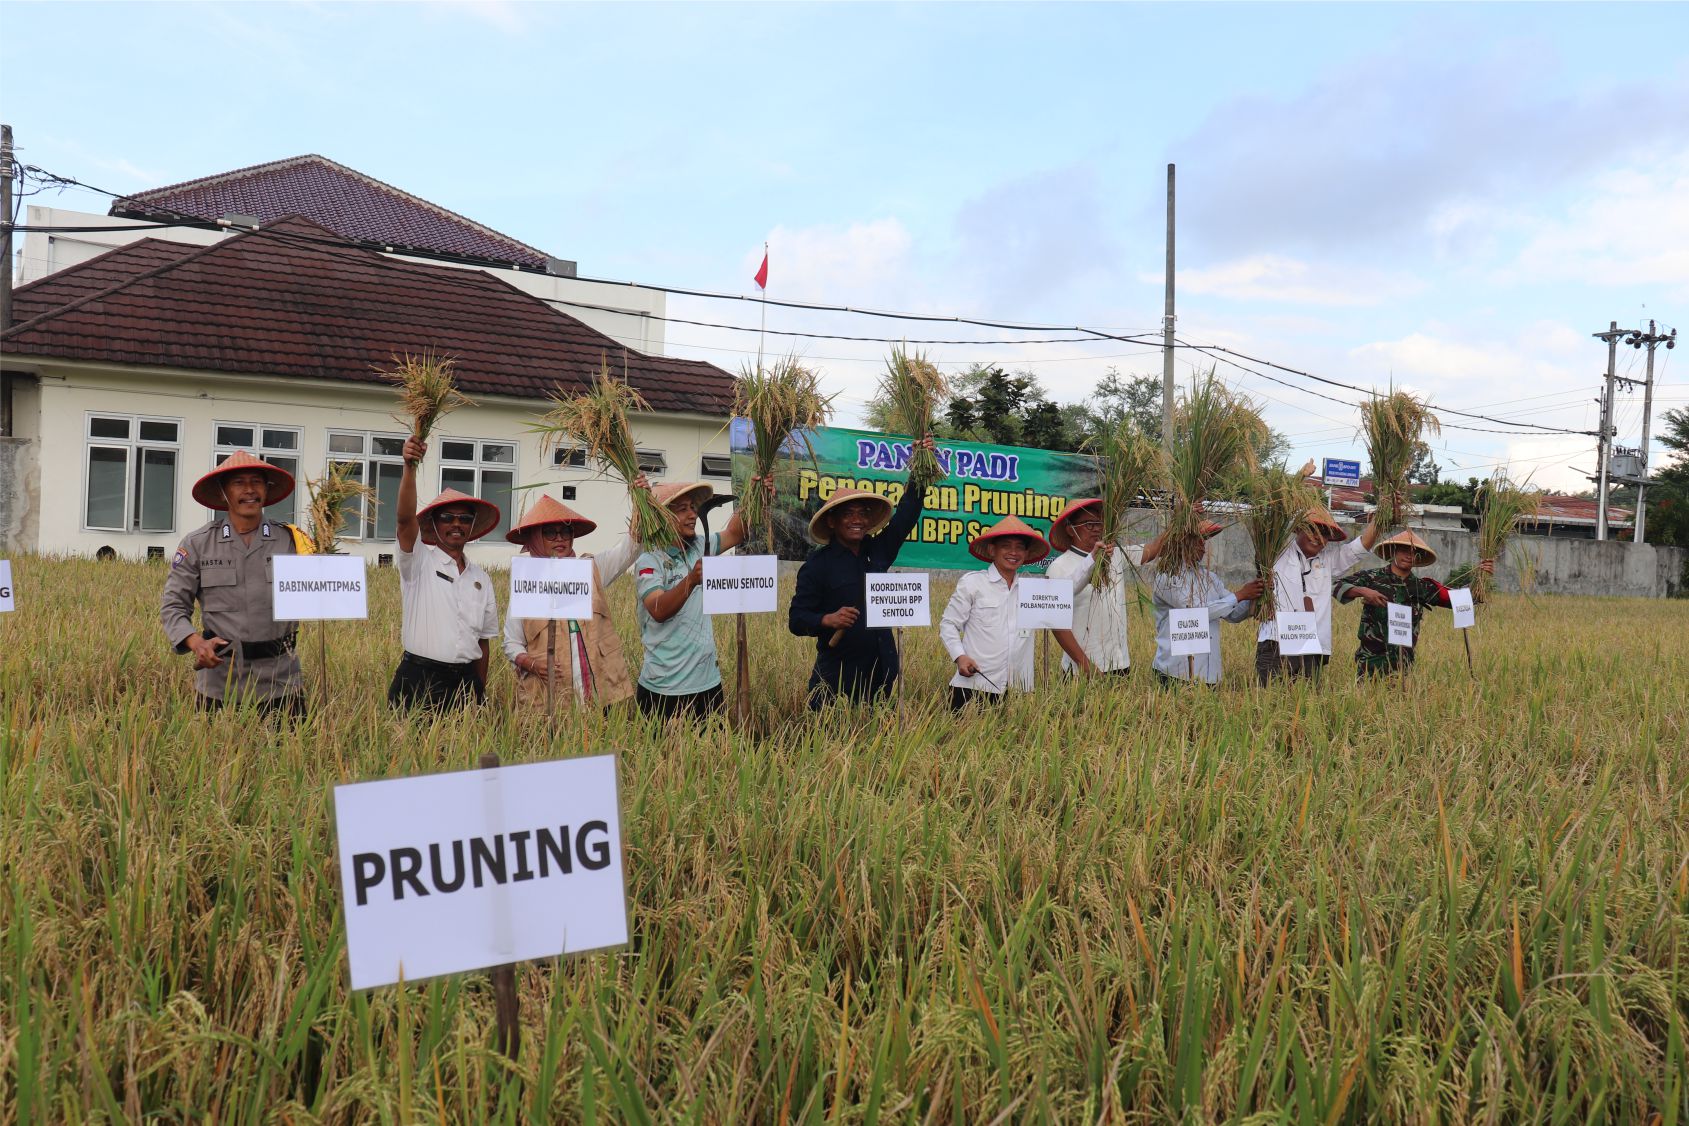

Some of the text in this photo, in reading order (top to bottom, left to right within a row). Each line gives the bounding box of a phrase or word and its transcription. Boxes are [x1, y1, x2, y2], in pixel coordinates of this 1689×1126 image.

[857, 440, 1019, 482] PANN PADI
[799, 469, 1066, 522] Peraan Pruning
[924, 519, 963, 543] BPP
[279, 581, 361, 593] BABINKAMTIPMAS
[514, 580, 589, 595] LURAH BANGUNCIPTO
[706, 577, 774, 590] PANEWU SENTOLO
[870, 583, 922, 592] KOORDINATOR
[871, 595, 922, 604] PENYULUH BPP
[1020, 602, 1055, 610] POLBANGTAN
[882, 608, 914, 617] SENTOLO
[352, 820, 611, 906] PRUNING
